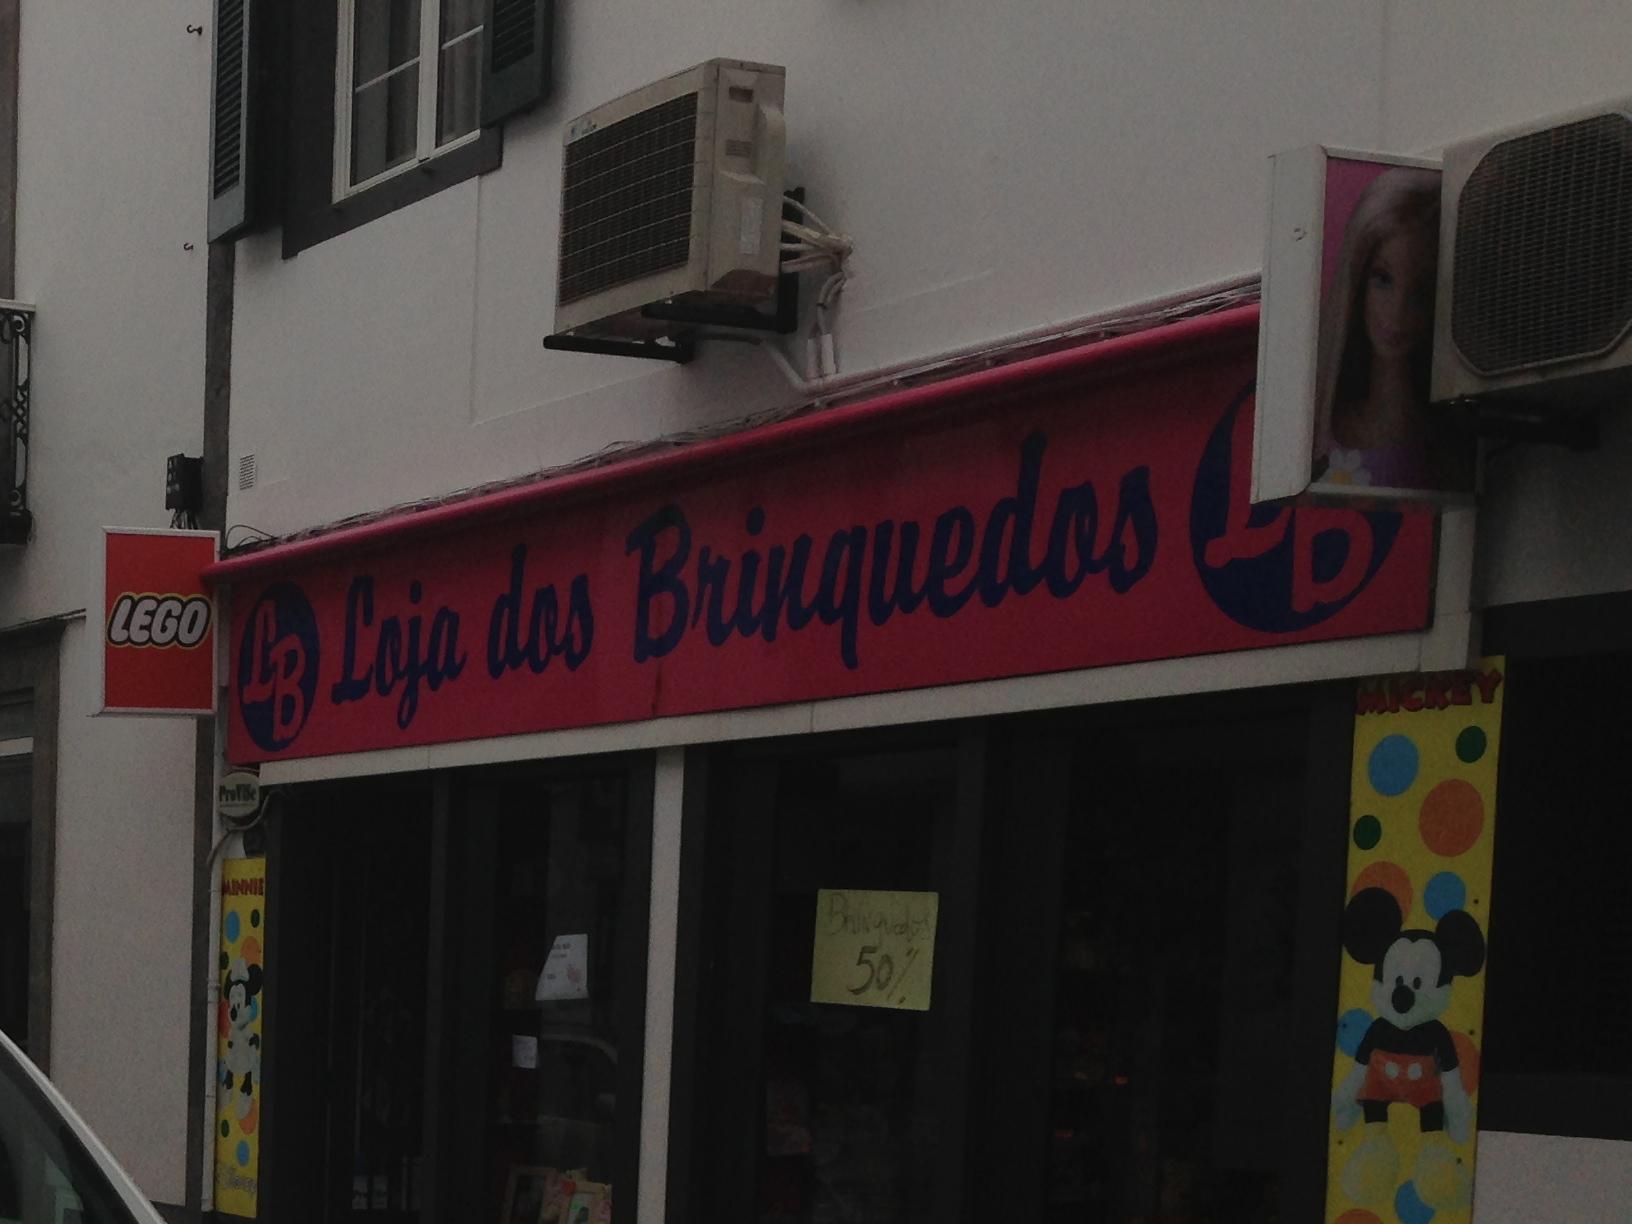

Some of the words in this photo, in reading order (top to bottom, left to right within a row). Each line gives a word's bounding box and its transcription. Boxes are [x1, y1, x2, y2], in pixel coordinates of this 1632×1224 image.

[331, 575, 467, 730] Loja
[486, 543, 594, 680] dos
[626, 431, 1159, 670] Brinquedos
[107, 592, 213, 648] LEGO
[240, 600, 308, 742] LB
[1354, 667, 1503, 716] MICKEY
[221, 877, 264, 896] MINNIE
[847, 944, 921, 1005] 50%
